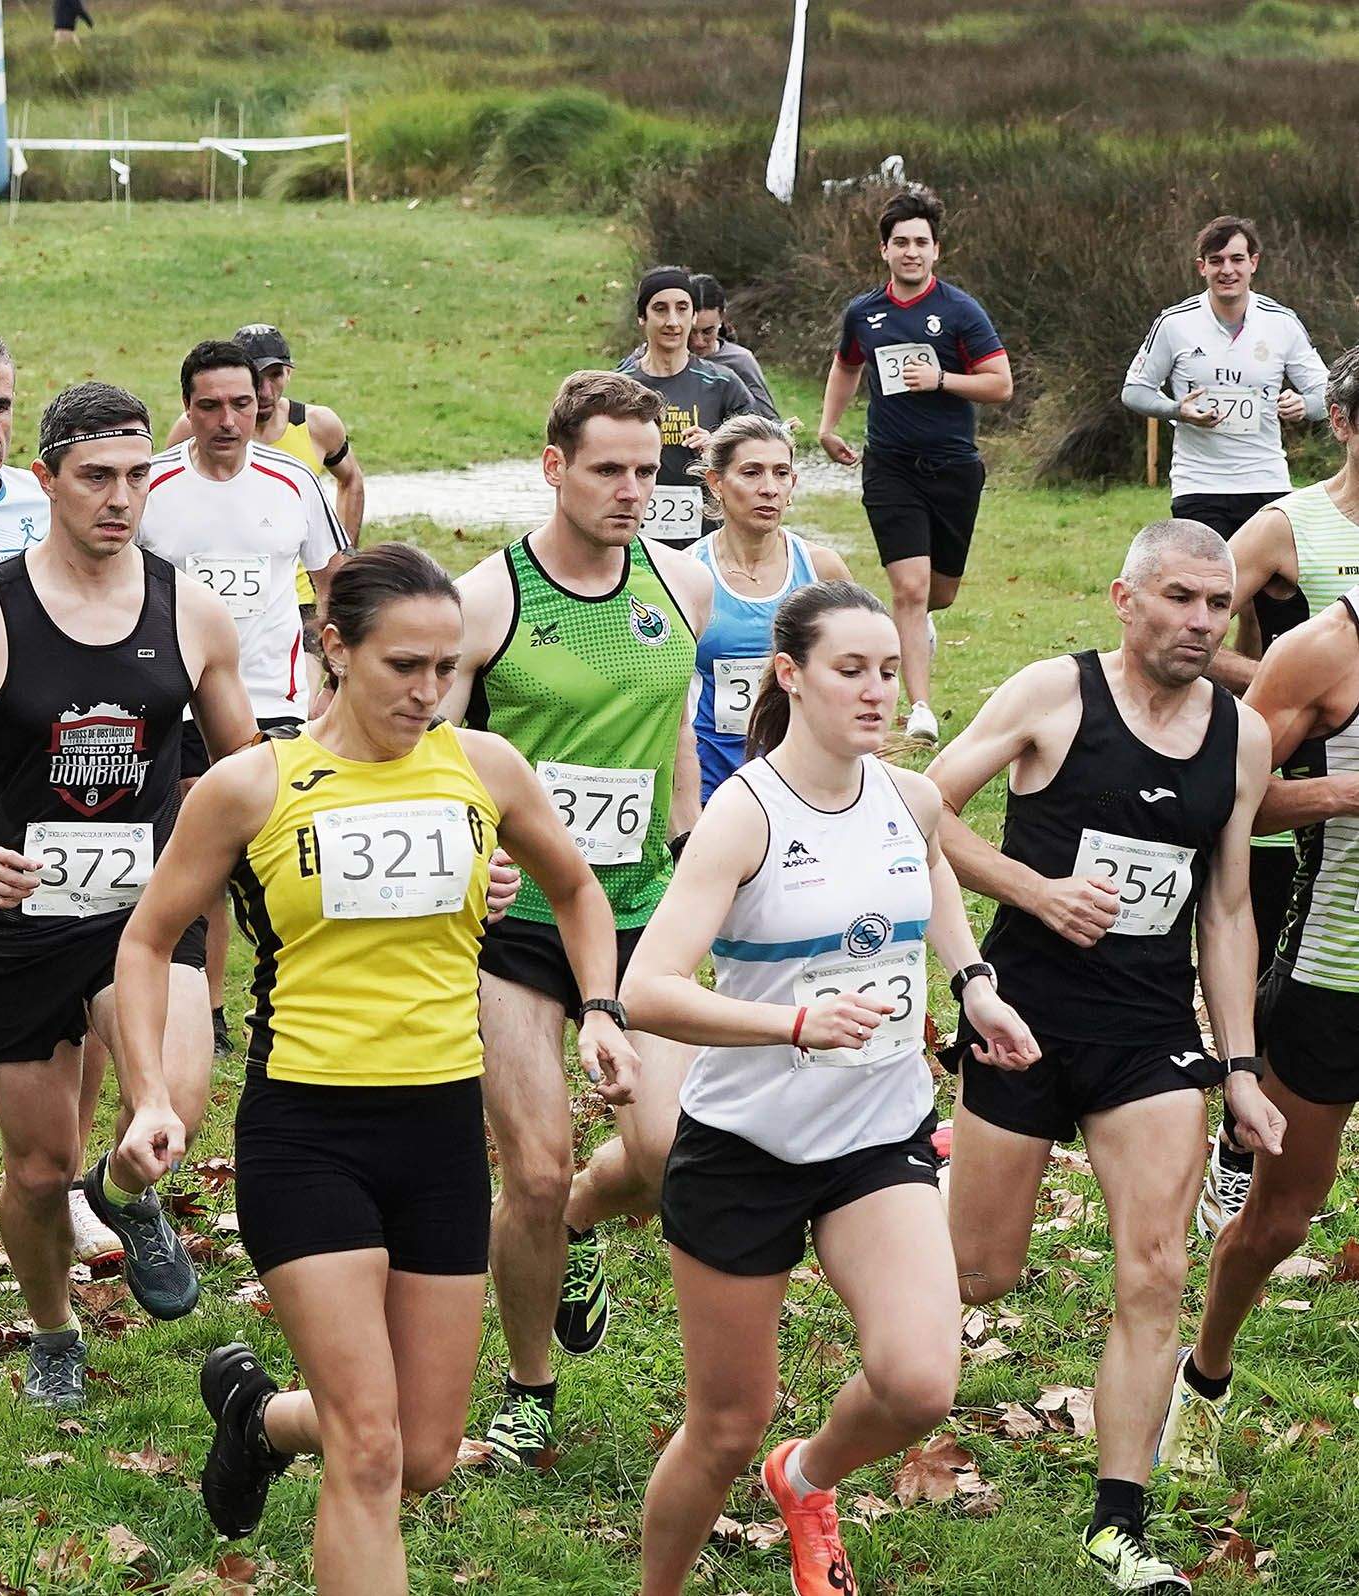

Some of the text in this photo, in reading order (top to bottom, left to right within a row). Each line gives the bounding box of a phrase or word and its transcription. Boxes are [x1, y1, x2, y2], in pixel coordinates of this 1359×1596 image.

[1215, 368, 1242, 384] Fly
[667, 411, 691, 422] TRAIL
[660, 421, 678, 432] OVA
[661, 433, 689, 445] RUX
[644, 499, 695, 522] 323
[198, 569, 261, 597] 325
[530, 634, 561, 648] ZICO
[62, 744, 133, 755] CONCELLO DE
[552, 788, 640, 835] 376
[341, 828, 454, 881] 321
[41, 847, 138, 888] 372
